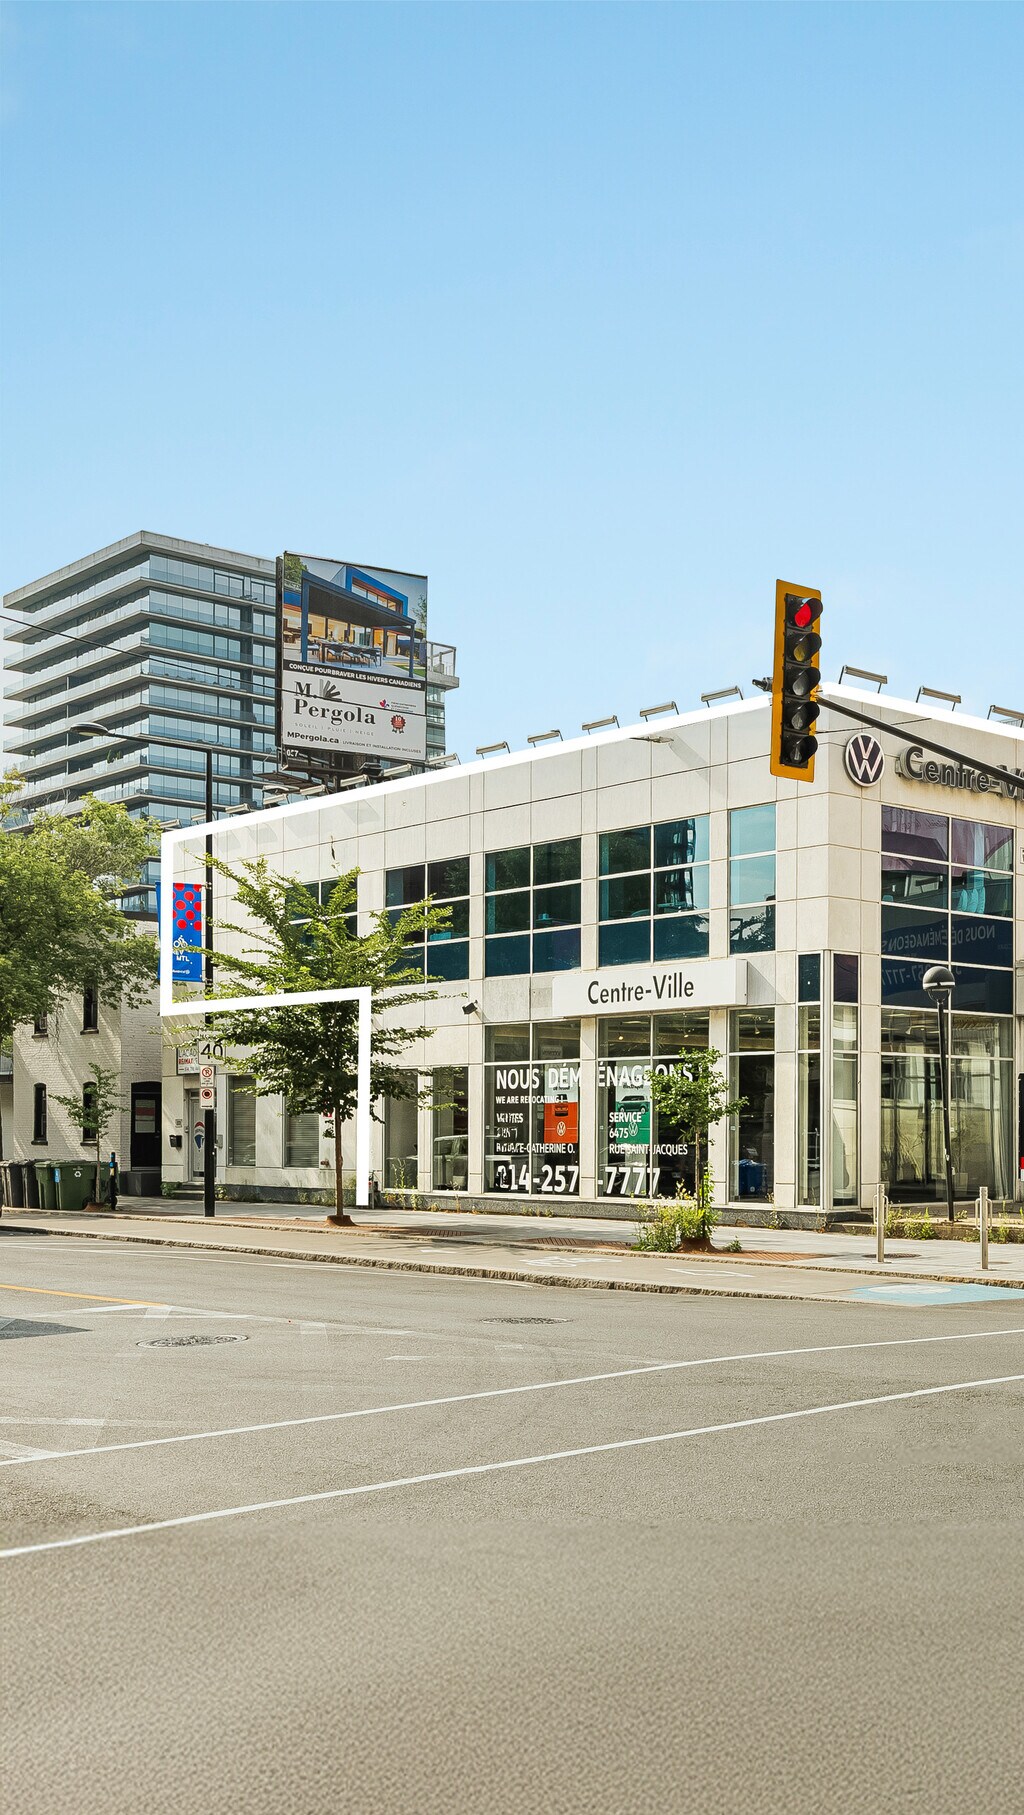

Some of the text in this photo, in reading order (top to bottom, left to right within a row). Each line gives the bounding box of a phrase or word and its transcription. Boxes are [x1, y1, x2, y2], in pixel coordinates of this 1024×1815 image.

[289, 663, 314, 672] CONÇUE
[314, 666, 332, 675] POUR
[331, 670, 355, 679] BRAVER
[367, 675, 388, 684] HIVERS
[388, 679, 422, 689] CANADIENS
[293, 698, 376, 726] Pergola
[287, 731, 340, 744] MPergola.ca
[588, 972, 694, 1004] Centre-Ville
[200, 1043, 224, 1060] 40
[496, 1068, 540, 1089] NOUS
[495, 1096, 506, 1104] WE
[506, 1096, 519, 1104] ARE
[609, 1111, 642, 1123] SERVICE
[609, 1127, 629, 1139] 6475
[567, 1143, 576, 1154] O.
[609, 1143, 625, 1155] RUE
